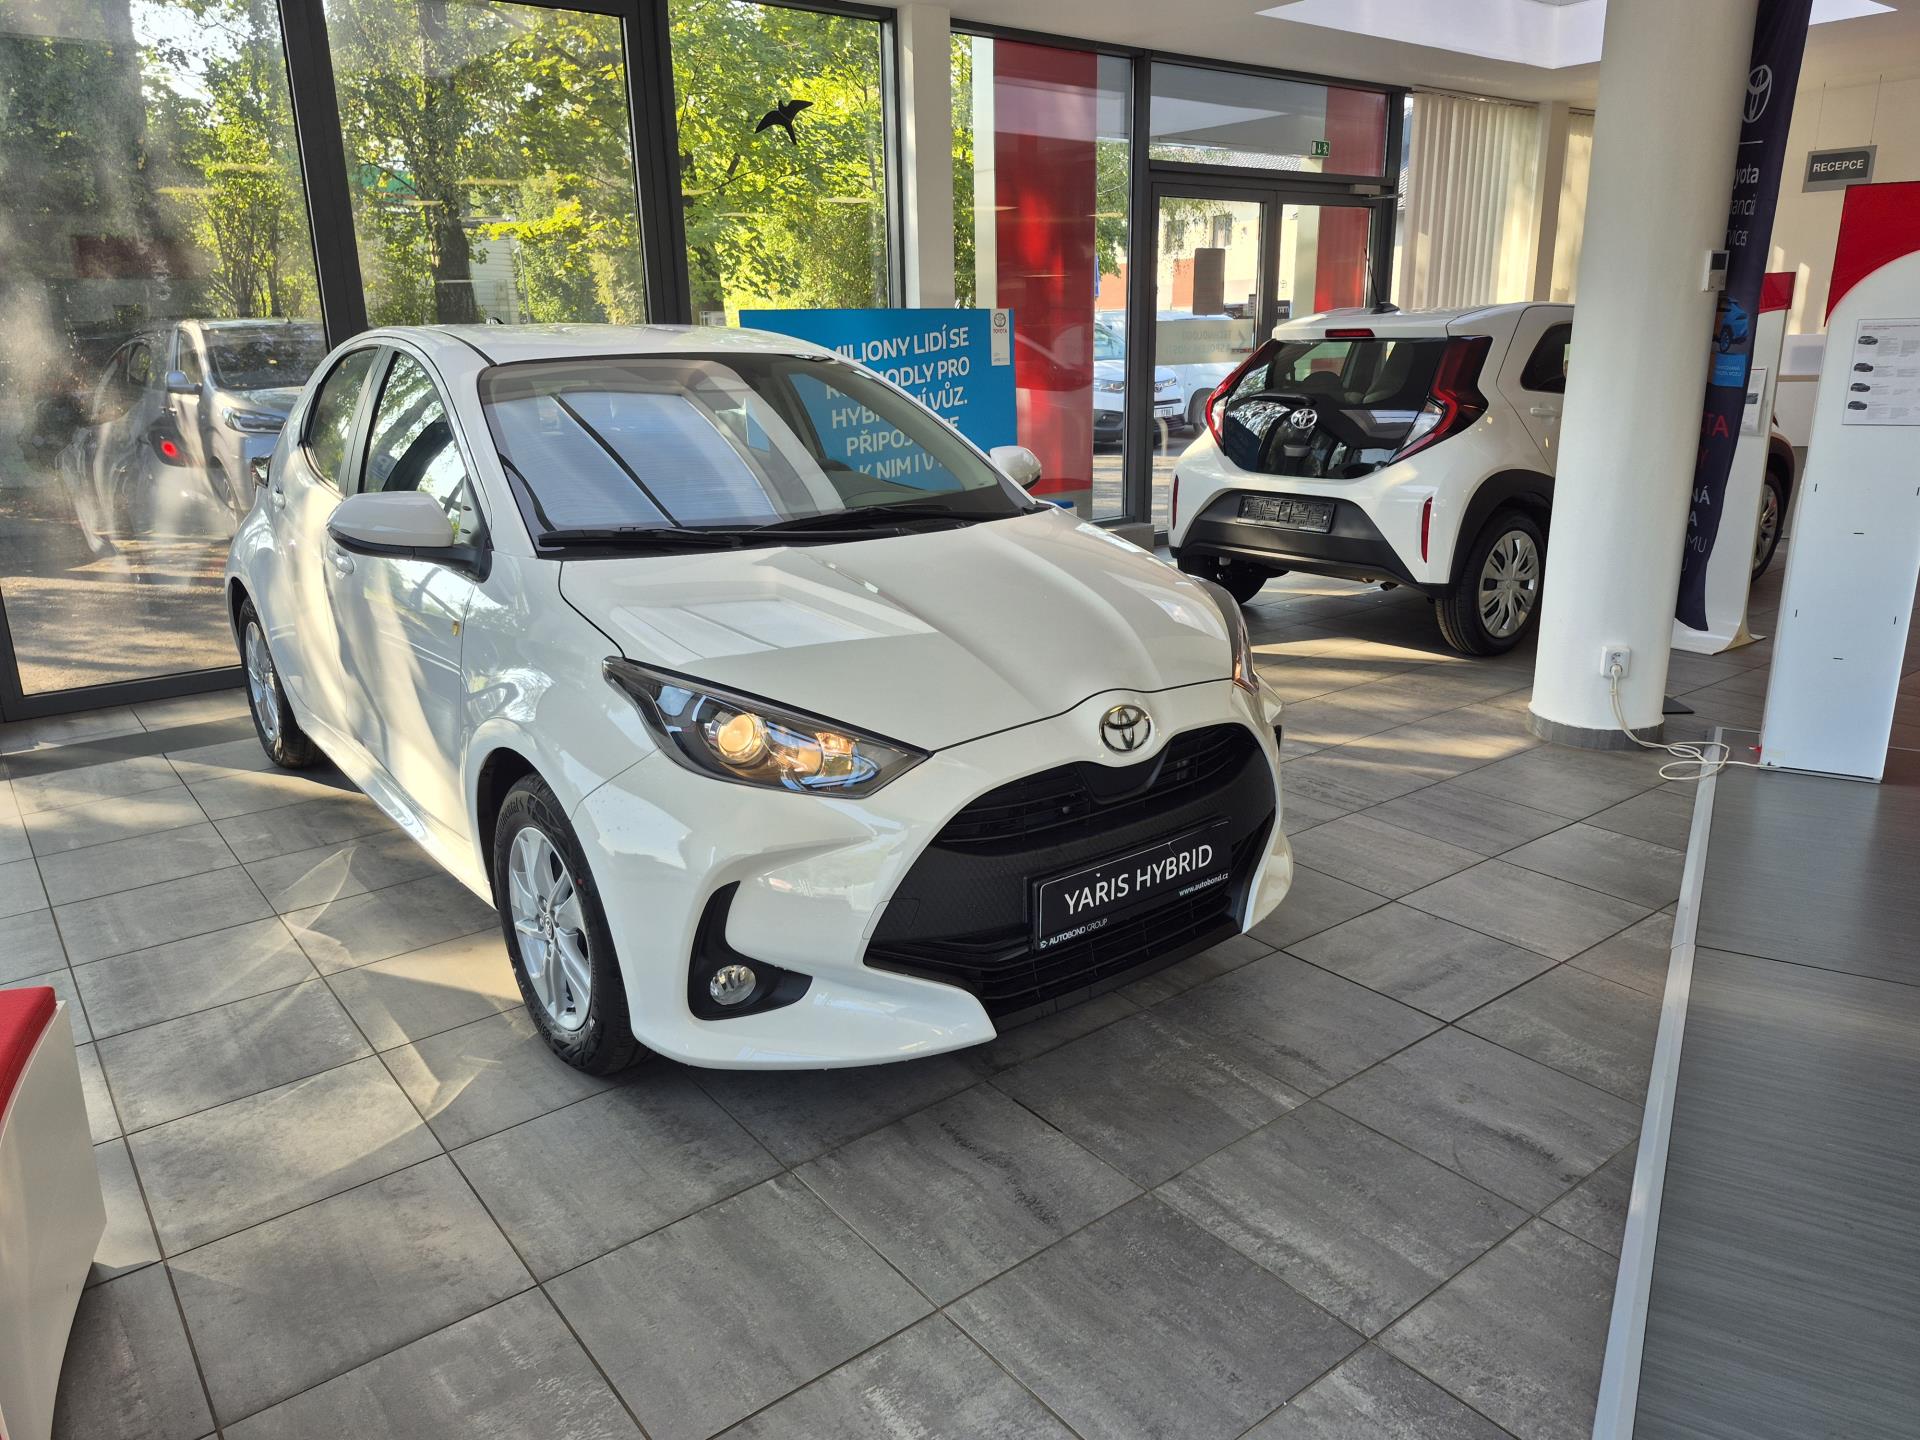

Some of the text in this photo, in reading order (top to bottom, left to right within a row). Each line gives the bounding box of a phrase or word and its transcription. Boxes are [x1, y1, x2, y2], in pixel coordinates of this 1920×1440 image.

[1733, 163, 1760, 190] yota
[1812, 159, 1865, 173] RECEPCE
[913, 324, 947, 354] LIDÍ
[949, 327, 969, 348] SE
[937, 356, 970, 380] PRO
[929, 381, 968, 411] VŮZ.
[877, 456, 911, 479] NIM
[1064, 844, 1213, 915] YARIS HYBRID
[1178, 872, 1229, 897] www.autobond.cz
[1048, 918, 1108, 946] AUTOBOND GROUP
